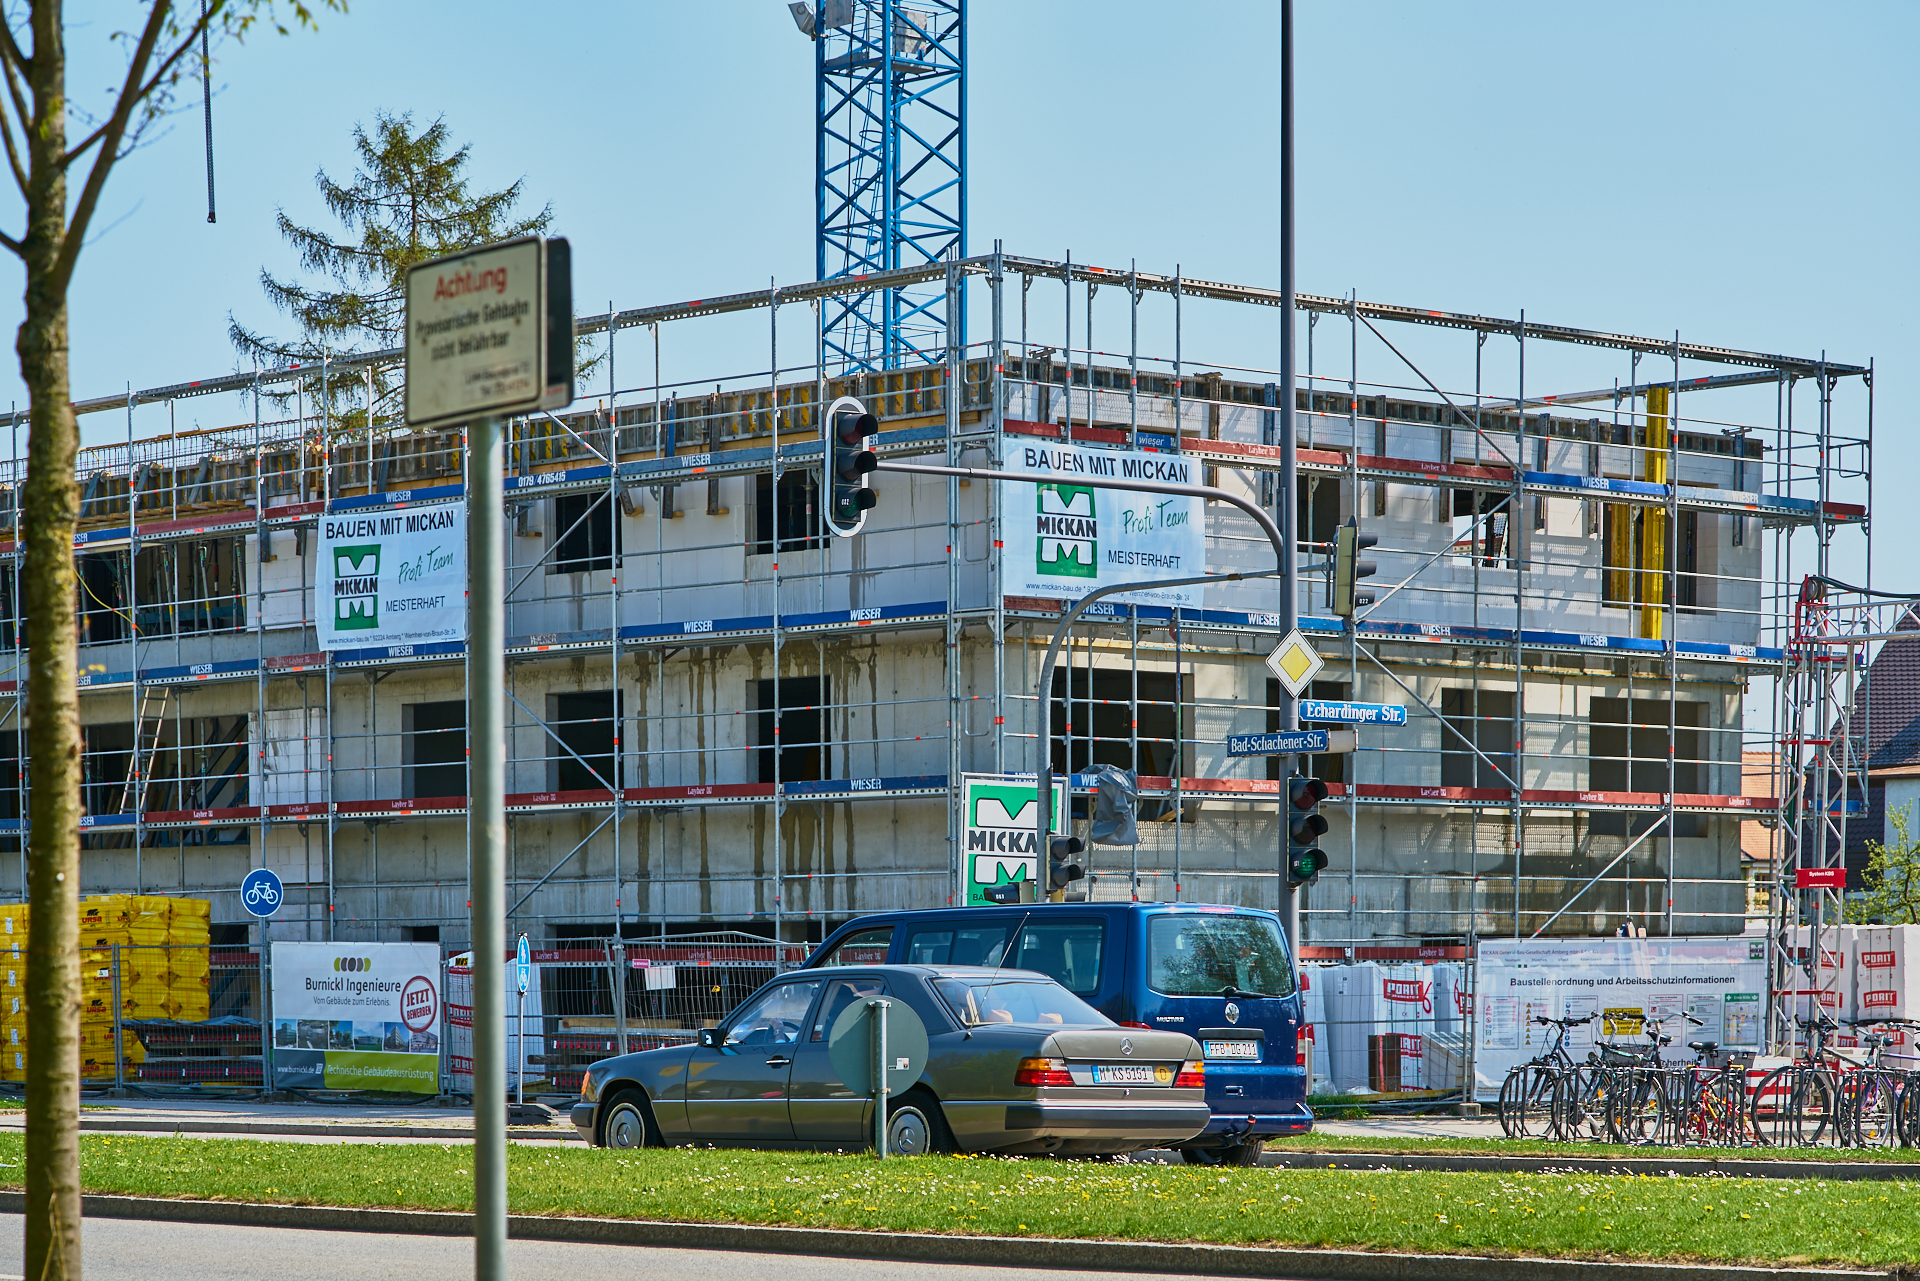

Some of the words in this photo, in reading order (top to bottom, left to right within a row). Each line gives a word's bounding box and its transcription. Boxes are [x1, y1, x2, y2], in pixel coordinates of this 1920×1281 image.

[434, 266, 508, 302] Achtung
[457, 331, 510, 354] befahrbar
[1138, 436, 1165, 447] wieser
[1248, 445, 1268, 455] Layher
[681, 453, 711, 467] WIESER
[1025, 447, 1084, 472] BAUEN
[1089, 456, 1116, 476] MIT
[1122, 458, 1188, 483] MICKAN
[1421, 463, 1441, 472] Layher
[1581, 477, 1610, 490] WIESER
[386, 490, 411, 503] WIESER
[1732, 491, 1759, 504] WIESER
[1123, 506, 1153, 535] Profi
[1156, 499, 1189, 528] Team
[326, 519, 376, 539] BAUEN
[380, 517, 402, 536] MIT
[406, 510, 454, 533] MICKAN
[1036, 516, 1098, 538] MICKAN
[73, 532, 88, 544] ESER
[398, 555, 423, 584] Profi
[427, 545, 454, 573] Team
[1108, 549, 1181, 569] MEISTERHAFT
[334, 577, 379, 596] MICKAN
[1025, 582, 1082, 593] www.mickan-bau.de
[385, 595, 446, 613] MEISTERHAFT
[850, 607, 882, 621] WIESER
[1247, 613, 1280, 626] WIESER
[683, 619, 713, 633] WIESER
[1420, 624, 1451, 637] WIESER
[327, 636, 370, 645] www.mickan-bau.de
[1579, 634, 1608, 648] WIESER
[388, 645, 414, 657] WIESER
[1730, 643, 1757, 658] WIESER
[190, 662, 213, 675] WIESER
[77, 674, 91, 686] ESER
[1306, 702, 1379, 723] Echardinger
[1381, 707, 1402, 722] Str.
[1231, 733, 1324, 753] Bad-Schachener-Str.
[687, 786, 706, 796] Layher
[850, 778, 882, 791] WIESER
[1420, 787, 1440, 797] Layher
[1580, 792, 1597, 802] Layher
[391, 799, 408, 809] Layher
[1728, 797, 1745, 807] Layher
[193, 810, 208, 819] Layher
[968, 829, 1038, 853] MICKA
[536, 952, 553, 961] Layher
[854, 951, 874, 962] Layher
[1418, 948, 1437, 958] Layher
[1864, 953, 1892, 964] PORIT
[305, 977, 343, 992] Burnickl
[346, 978, 401, 996] Ingenieure
[1510, 977, 1595, 988] Baustellenordnung
[1597, 977, 1614, 986] und
[1615, 975, 1736, 985] Arbeitsschutzinformationen
[1386, 982, 1420, 995] PORIT
[313, 996, 325, 1005] Vom
[326, 995, 351, 1006] Gebäude
[352, 998, 365, 1006] zum
[365, 996, 391, 1007] Erlebnis.
[405, 988, 430, 1008] JETZT
[1866, 992, 1894, 1003] PORIT
[406, 1005, 432, 1021] BEWERBEN
[1210, 1043, 1226, 1055] FFB
[1231, 1043, 1241, 1055] DG
[1243, 1044, 1258, 1055] 211
[277, 1064, 315, 1075] www.burnickl.de
[327, 1064, 362, 1076] Technische
[363, 1065, 434, 1082] Gebäudeausrüstung
[1098, 1067, 1107, 1081] M
[1111, 1067, 1124, 1081] KS
[1126, 1066, 1148, 1081] 5151
[1159, 1068, 1167, 1081] D
